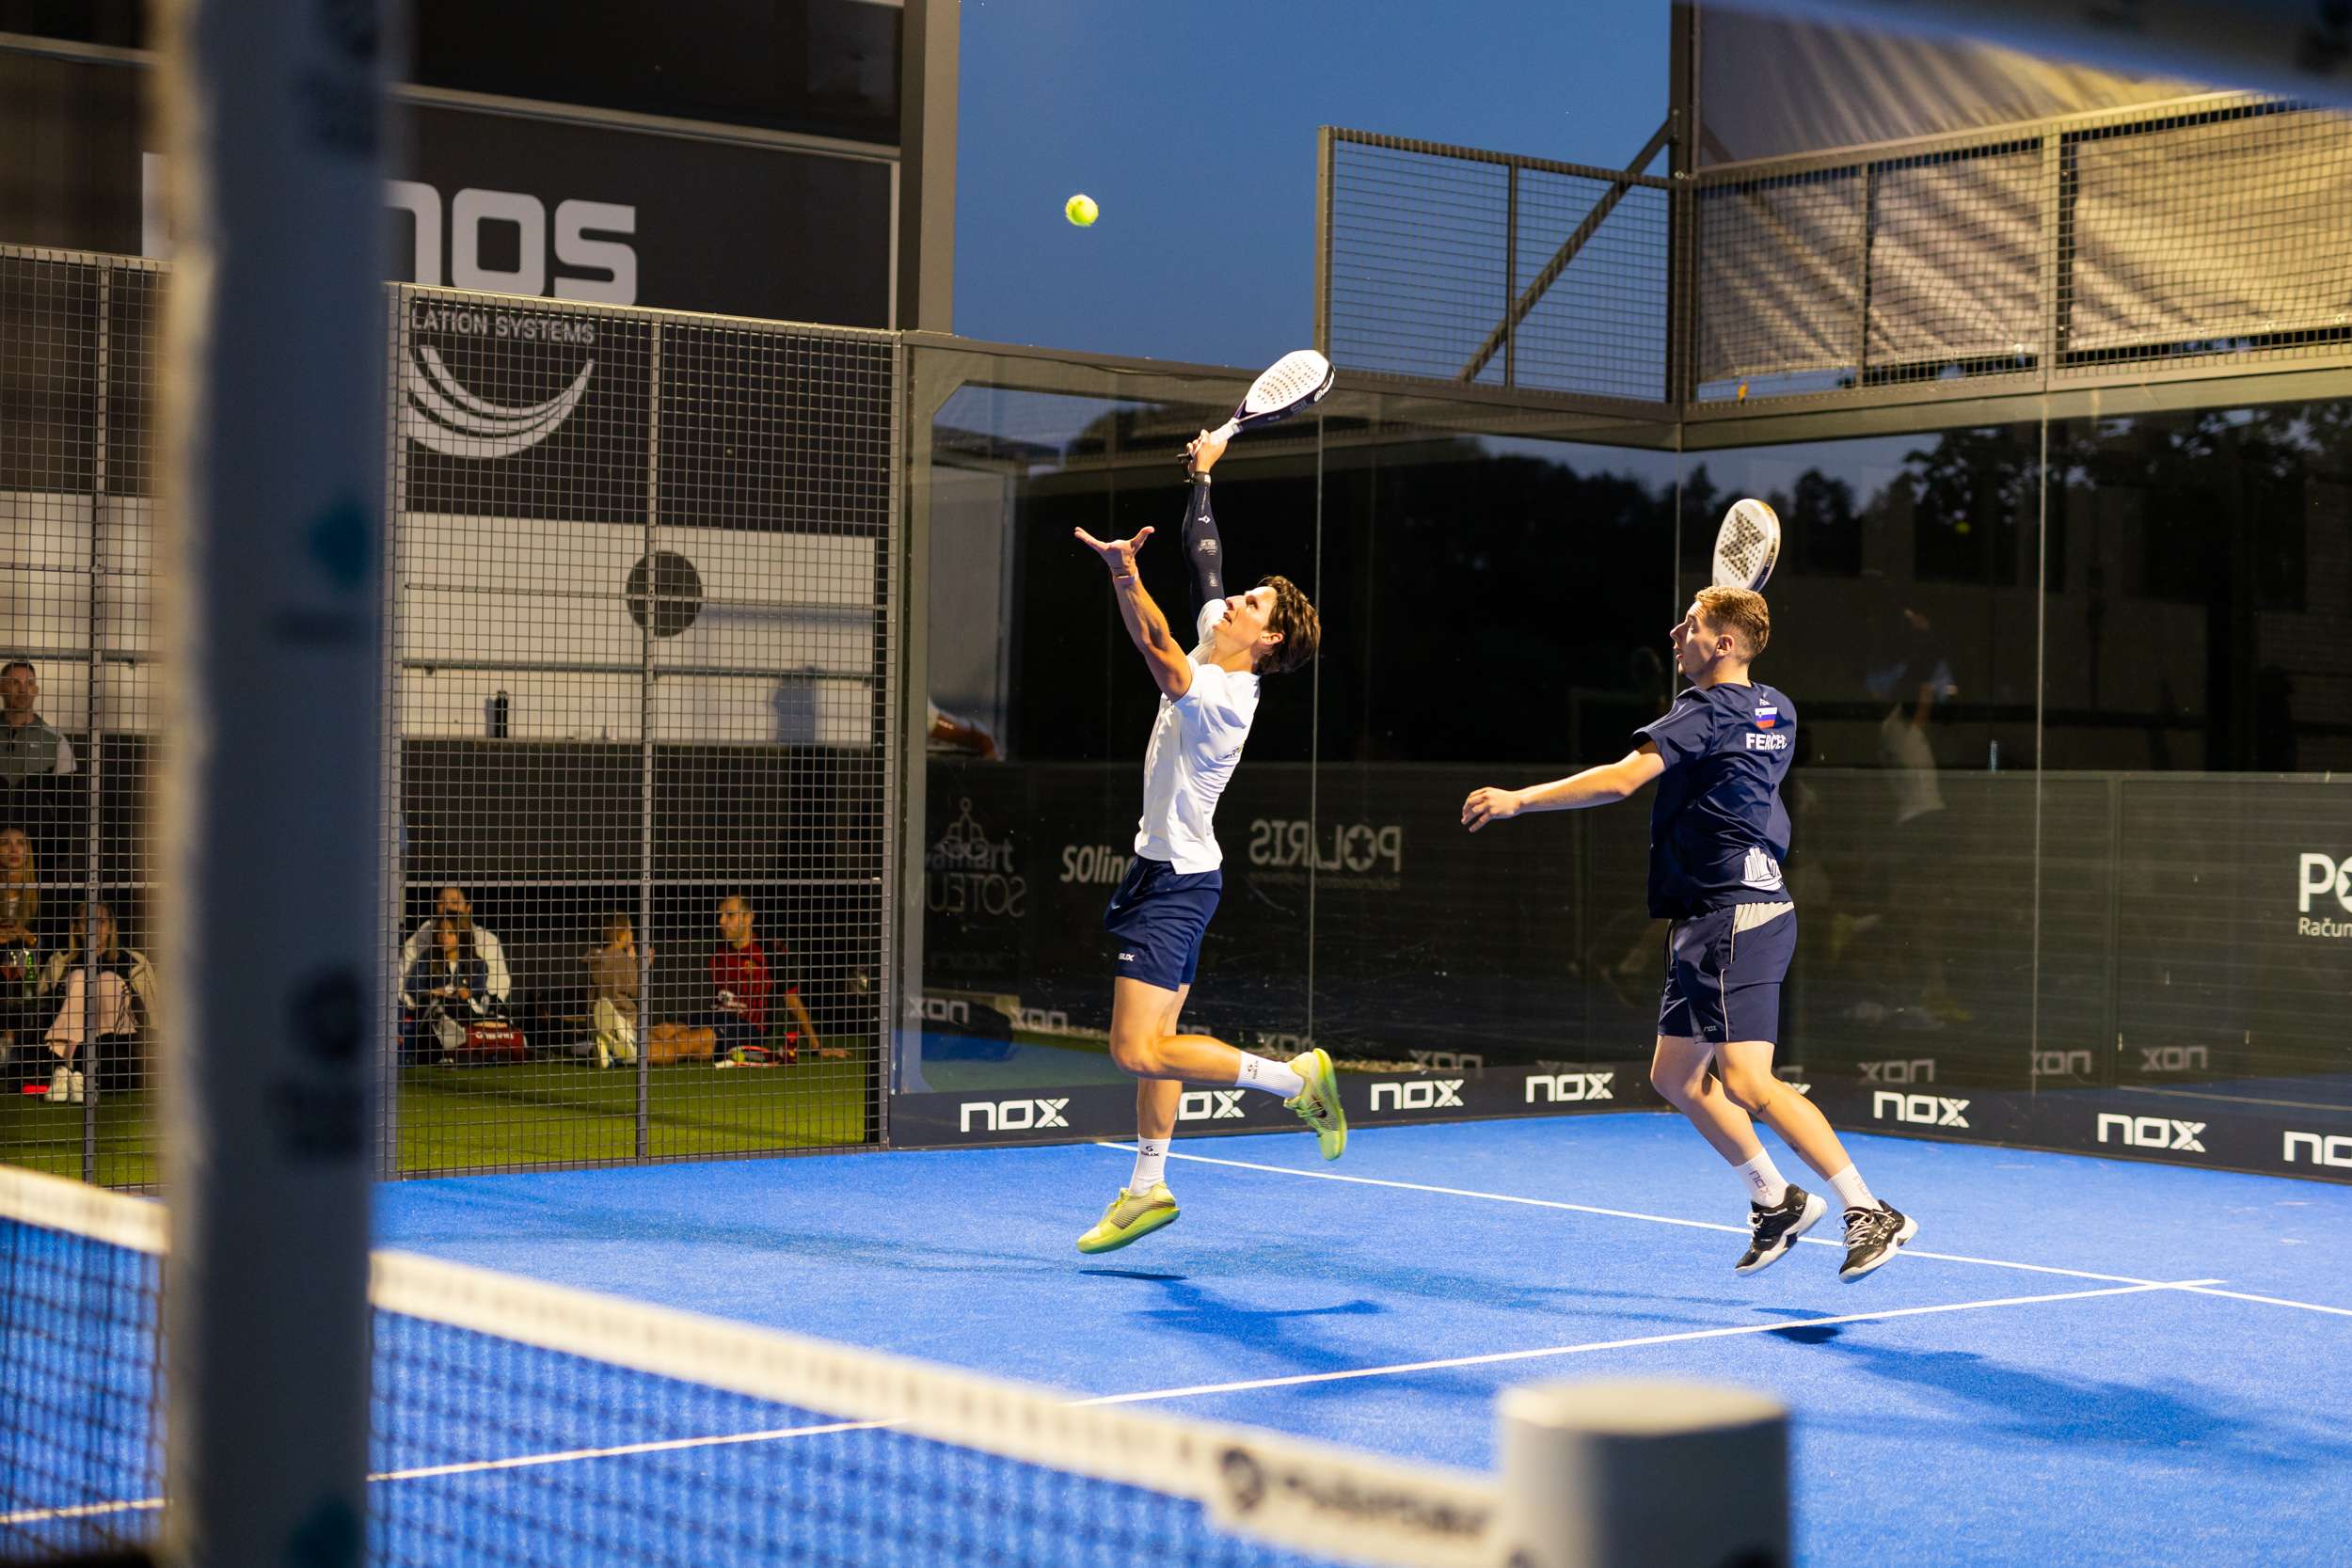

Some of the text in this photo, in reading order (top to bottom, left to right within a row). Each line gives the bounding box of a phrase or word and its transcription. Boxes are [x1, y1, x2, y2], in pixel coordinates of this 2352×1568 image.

[411, 307, 596, 345] LATION SYSTEMS
[2298, 916, 2352, 938] Račun
[1176, 1088, 1246, 1121] ox
[2283, 1131, 2352, 1168] no
